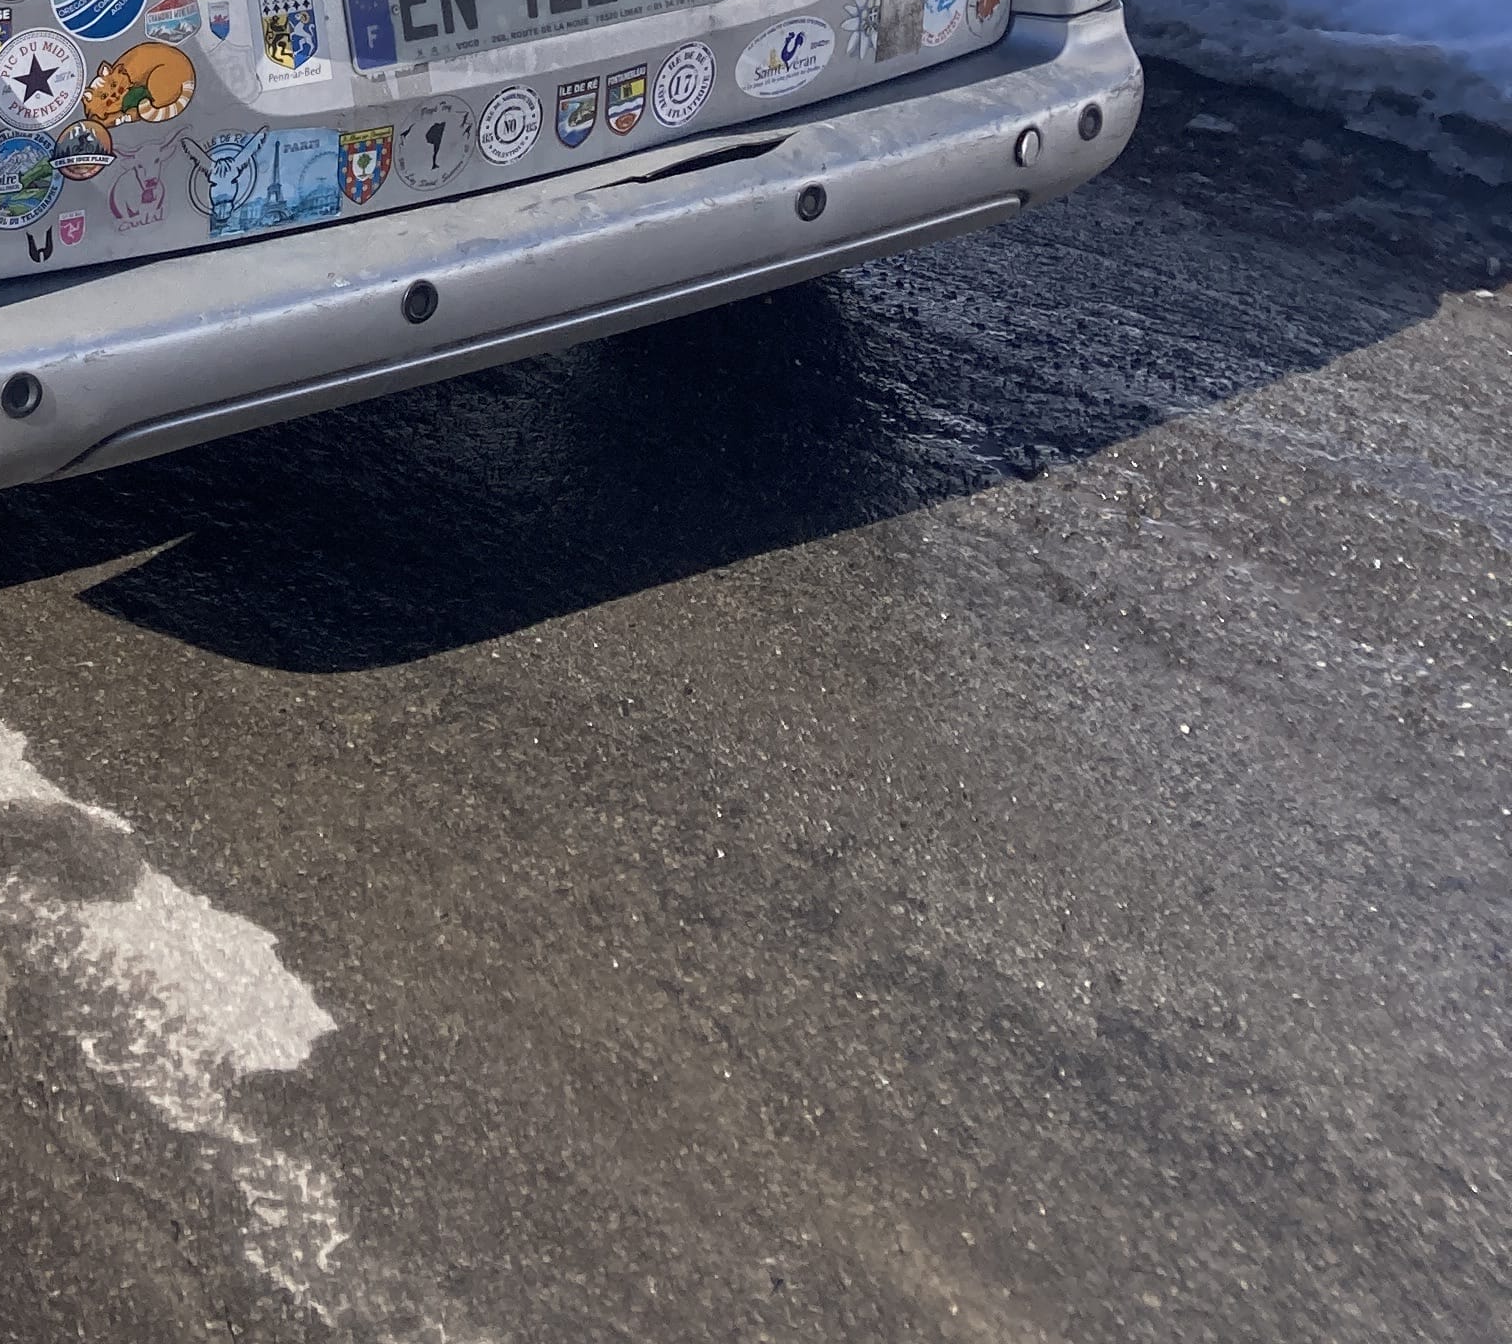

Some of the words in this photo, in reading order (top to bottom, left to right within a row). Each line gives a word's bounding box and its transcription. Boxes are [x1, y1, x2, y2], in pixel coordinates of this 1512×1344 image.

[366, 25, 379, 48] F
[1, 57, 18, 78] PIC
[19, 42, 37, 56] DU
[42, 41, 70, 64] MIDI
[268, 64, 322, 83] Penn-ar-Bed
[575, 82, 585, 94] DE
[675, 74, 694, 95] 17
[203, 139, 217, 150] ILE
[219, 135, 231, 144] DE
[283, 139, 321, 154] PARIS
